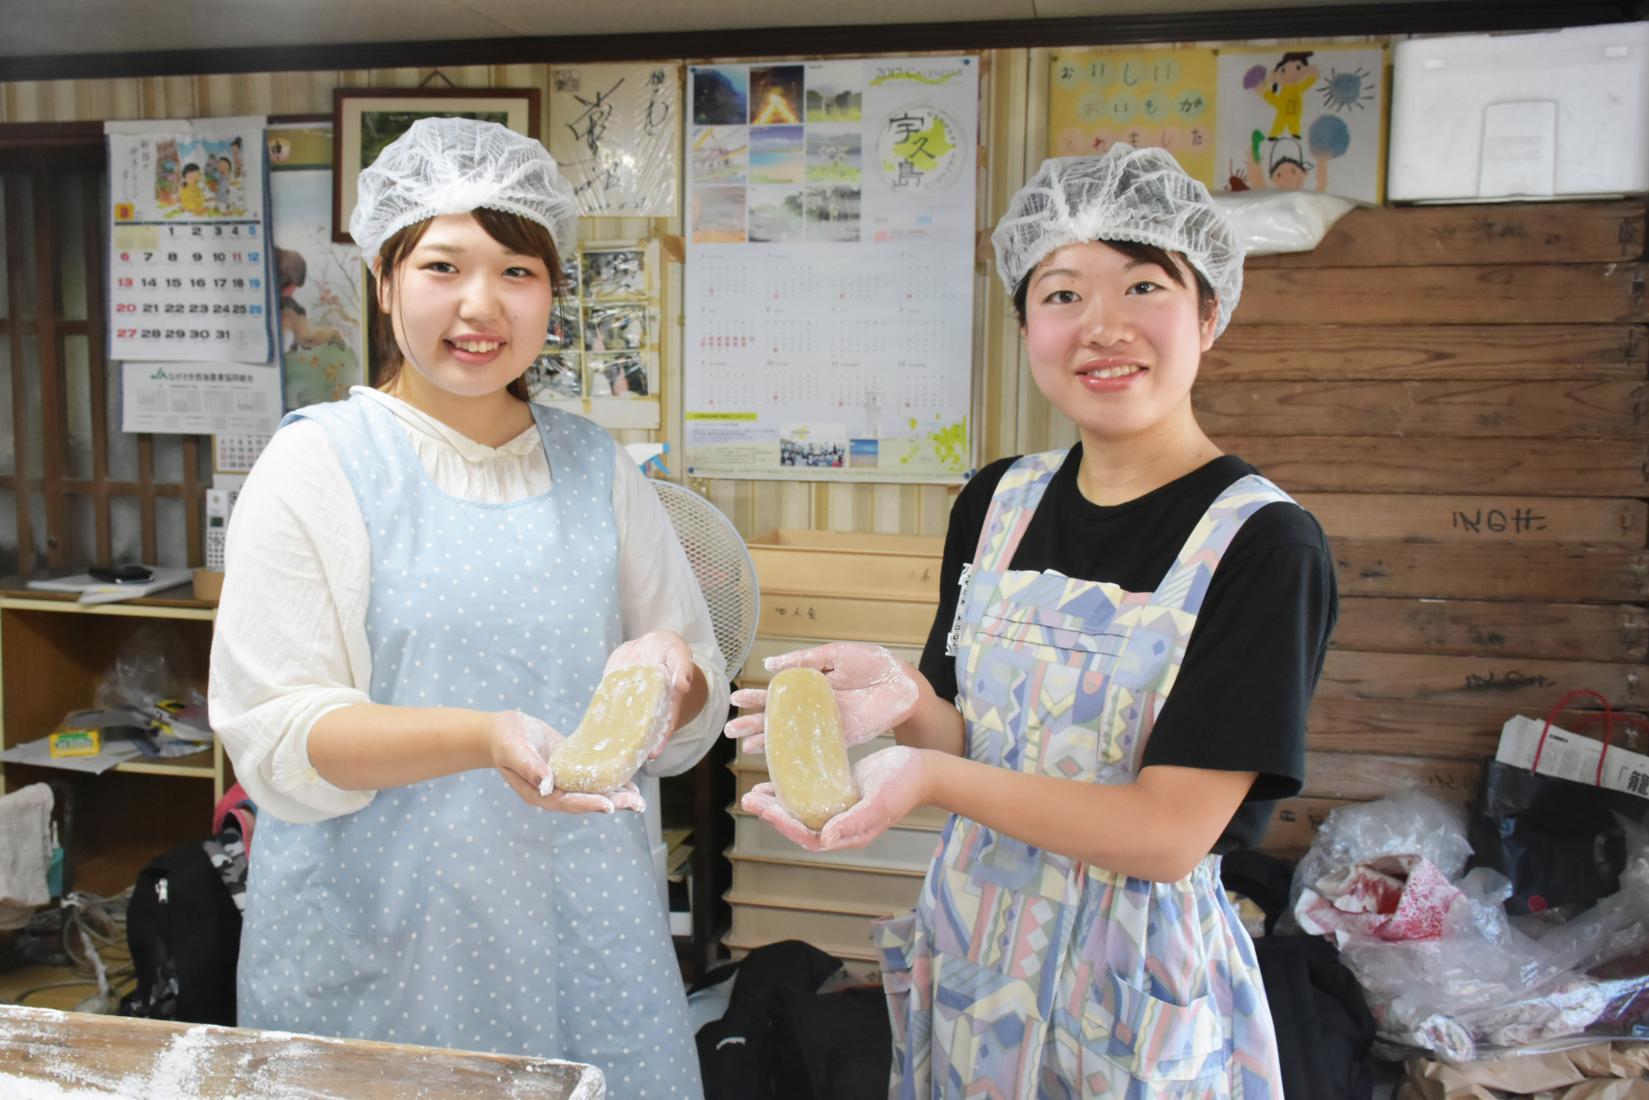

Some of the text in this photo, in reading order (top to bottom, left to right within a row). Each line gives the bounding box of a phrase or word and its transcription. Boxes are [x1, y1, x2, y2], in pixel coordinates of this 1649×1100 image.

[888, 112, 937, 188] 宇久島
[169, 227, 174, 236] 1
[192, 227, 201, 236] 2
[215, 227, 222, 236] 3
[232, 227, 239, 236] 4
[120, 252, 259, 262] 6 7 8 9 10 11 12
[117, 278, 133, 288] 13
[141, 278, 157, 288] 14
[166, 278, 182, 288] 15
[190, 278, 206, 288] 16
[214, 278, 227, 288] 17
[232, 278, 244, 288] 18
[116, 304, 136, 314] 20
[142, 304, 158, 314] 21
[164, 304, 185, 314] 22
[189, 304, 208, 314] 23
[213, 304, 230, 314] 24
[232, 304, 247, 314] 25
[116, 329, 230, 340] 27 28 29 30 31
